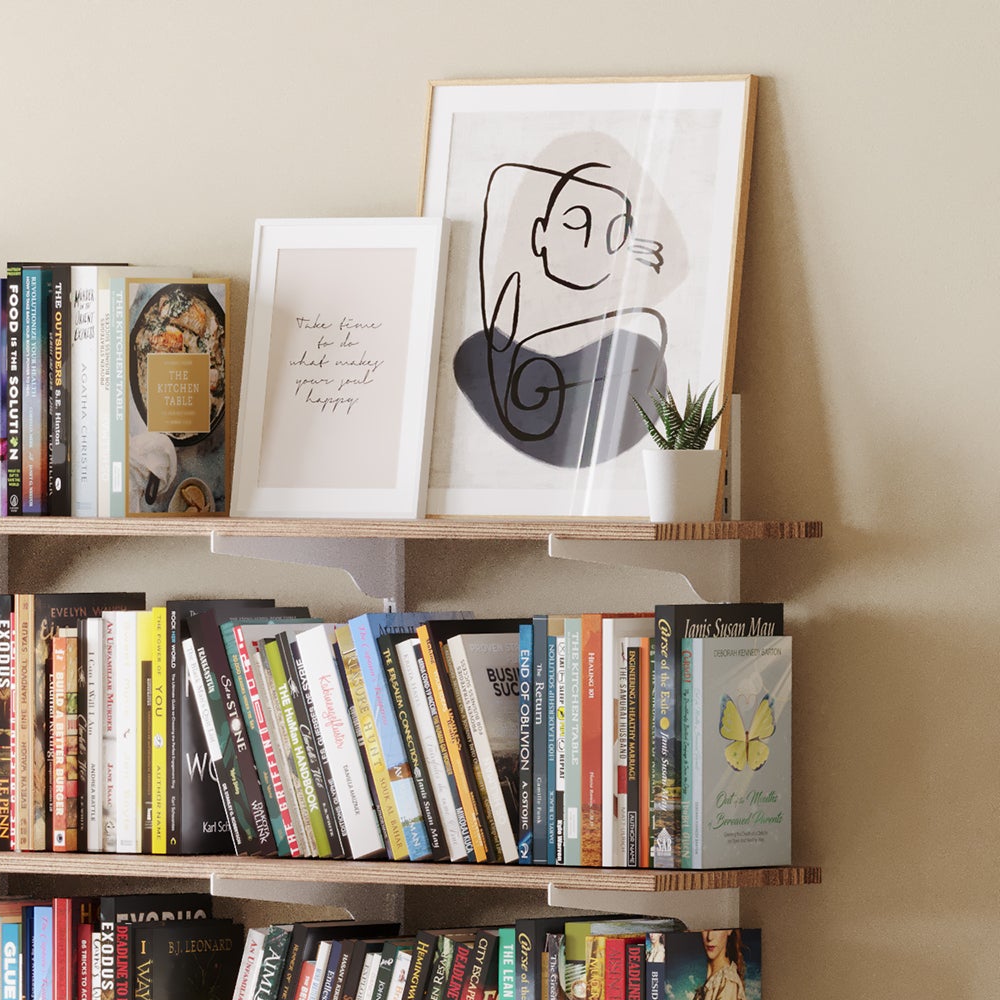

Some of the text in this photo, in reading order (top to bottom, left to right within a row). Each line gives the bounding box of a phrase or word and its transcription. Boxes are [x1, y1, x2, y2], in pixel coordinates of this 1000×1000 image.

[9, 284, 18, 371] FOOD THE
[296, 315, 382, 331] Take time
[317, 332, 359, 348] to do
[168, 371, 189, 381] THE
[289, 352, 384, 371] what makes
[158, 383, 200, 394] KITCHEN
[295, 370, 375, 395] your soul
[164, 396, 193, 407] TABLE
[305, 389, 359, 415] happy
[51, 607, 87, 618] EVELYN
[685, 620, 711, 638] Janis
[713, 619, 747, 638] Susan
[658, 619, 672, 715] Curse of the Exile
[155, 685, 163, 717] YOU
[381, 648, 421, 769] THE JERUSALEM CONNECTION
[520, 650, 530, 771] END OF OBLIVION
[535, 682, 544, 725] Return
[619, 666, 627, 759] THE SAMURAI HUSBAND
[55, 672, 65, 816] BUILD A BETTER BURGER
[225, 700, 248, 753] STONE
[276, 683, 319, 812] THE HuMan HANDBOOK
[0, 778, 9, 838] J.F. PENN
[521, 791, 529, 830] OSTOJIC
[202, 821, 217, 833] Karl
[101, 922, 114, 991] EXODUS
[116, 926, 128, 980] DEADLINE
[185, 939, 233, 952] LEONARD
[474, 937, 490, 965] CITY
[3, 941, 16, 1000] GLUE
[136, 960, 150, 1000] WAY
[116, 982, 128, 996] TO
